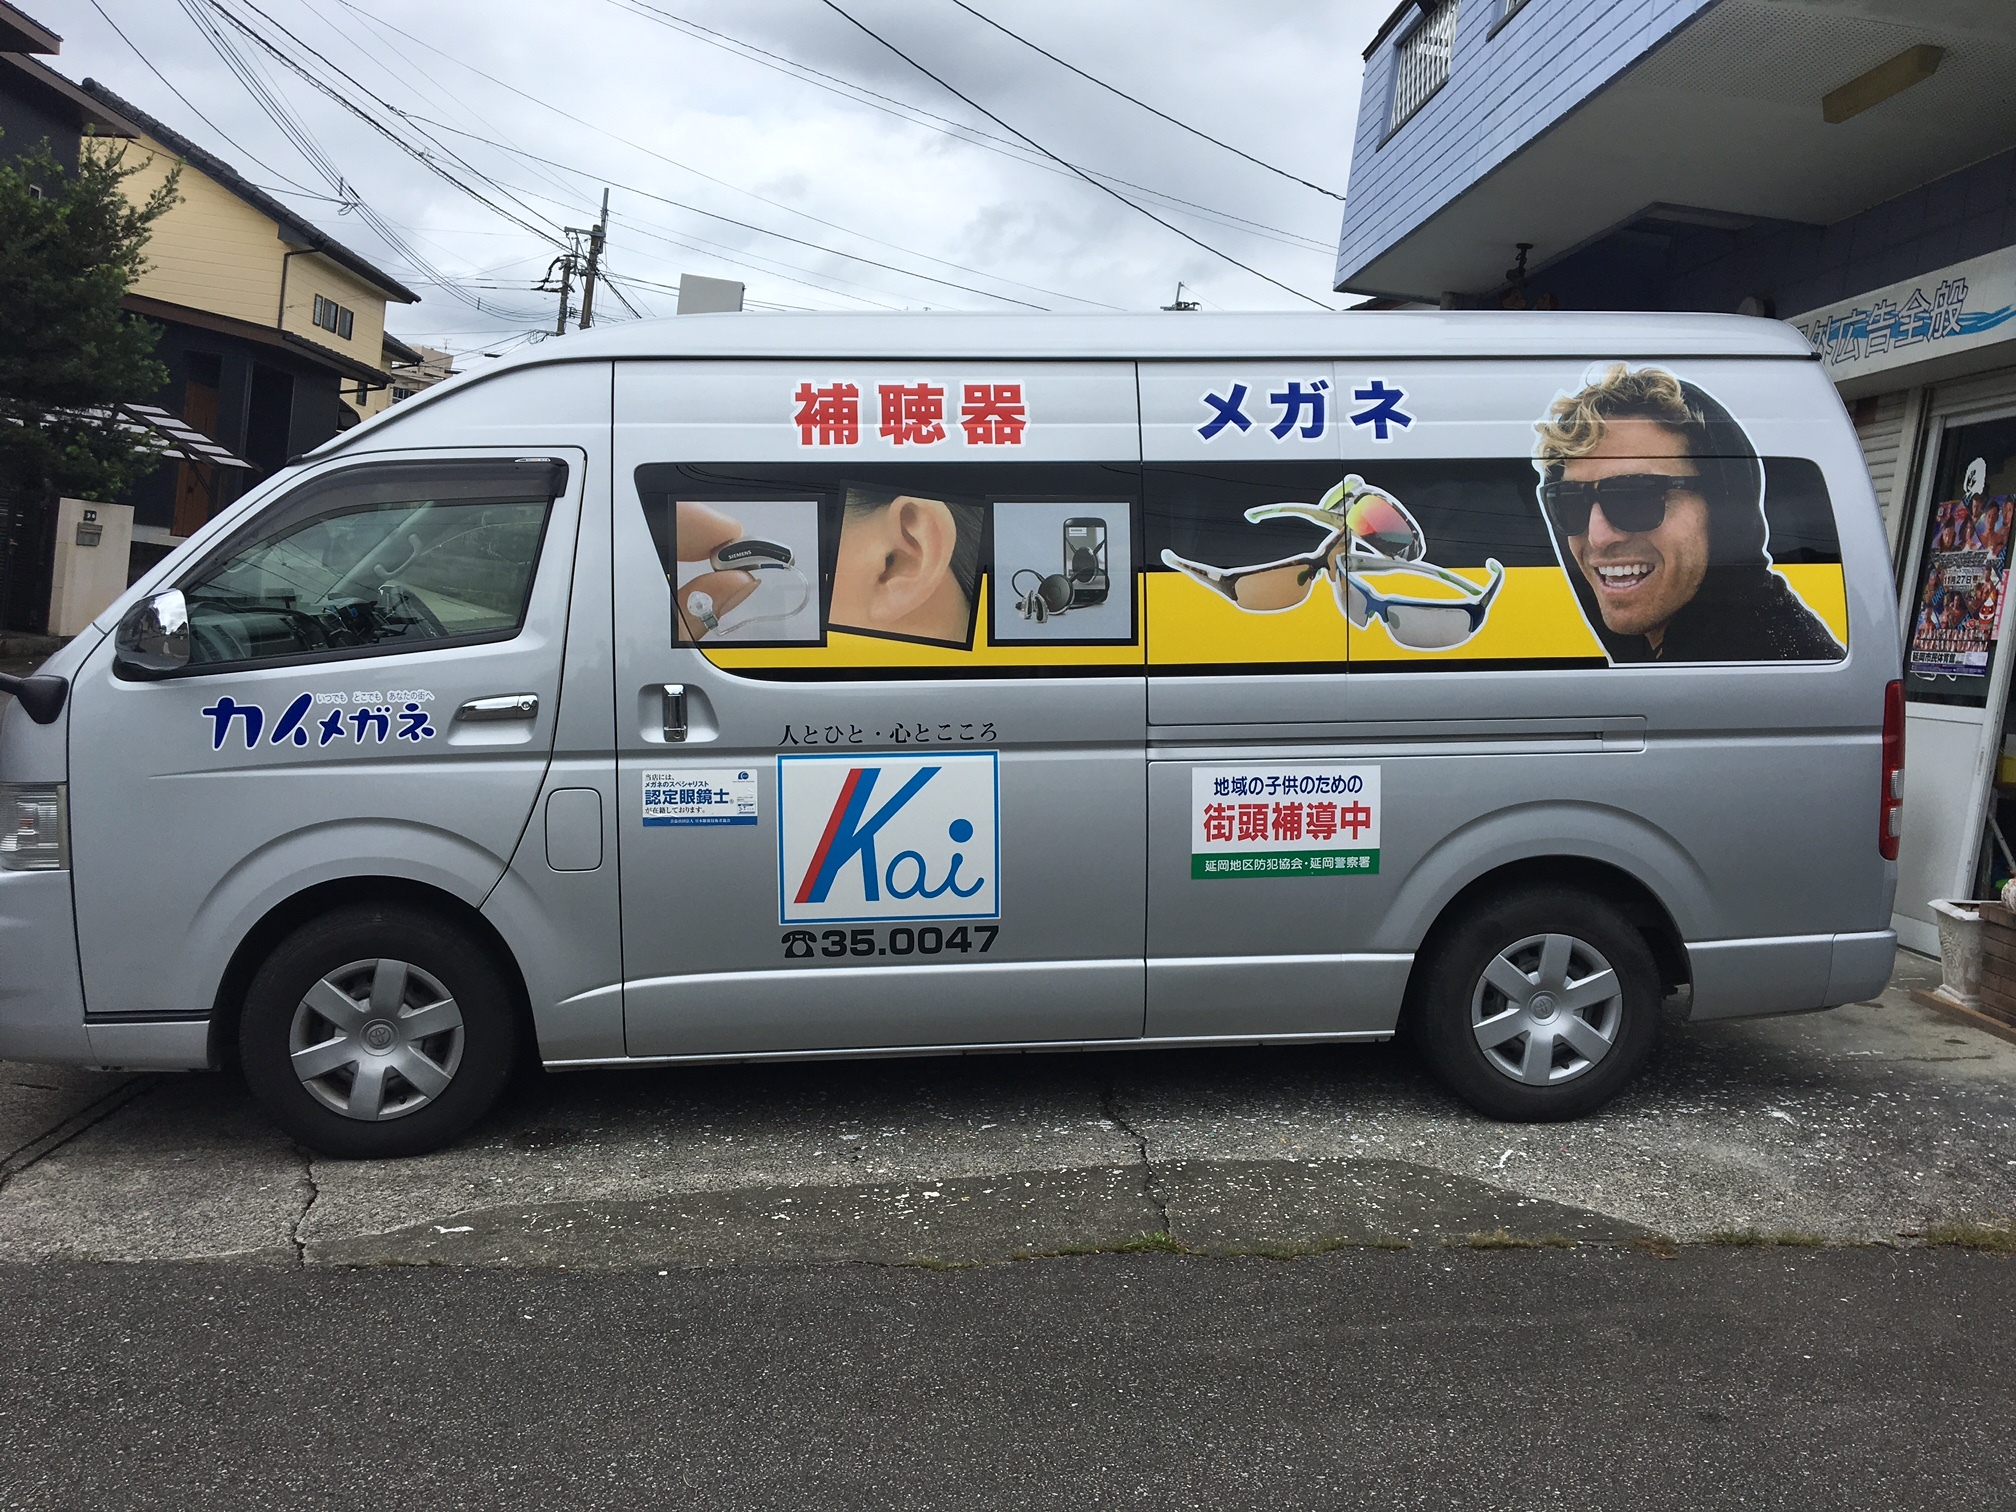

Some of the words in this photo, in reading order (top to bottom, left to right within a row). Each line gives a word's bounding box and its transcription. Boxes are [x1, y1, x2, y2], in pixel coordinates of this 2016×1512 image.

[794, 382, 1027, 446] 補聴器
[1197, 379, 1413, 441] メガネ
[727, 549, 753, 560] SIEMENS
[316, 693, 347, 703] いつでも
[353, 692, 382, 702] どこでも
[202, 692, 435, 750] カイメガネ
[778, 722, 998, 746] 人とひと・心とこころ
[1213, 774, 1363, 797] 地域の子供のための
[793, 766, 985, 904] Kai
[1203, 800, 1371, 843] 街頭補導中
[1204, 856, 1371, 872] 延岡地区防犯協会・延岡警察署
[820, 925, 999, 957] 35.0047
